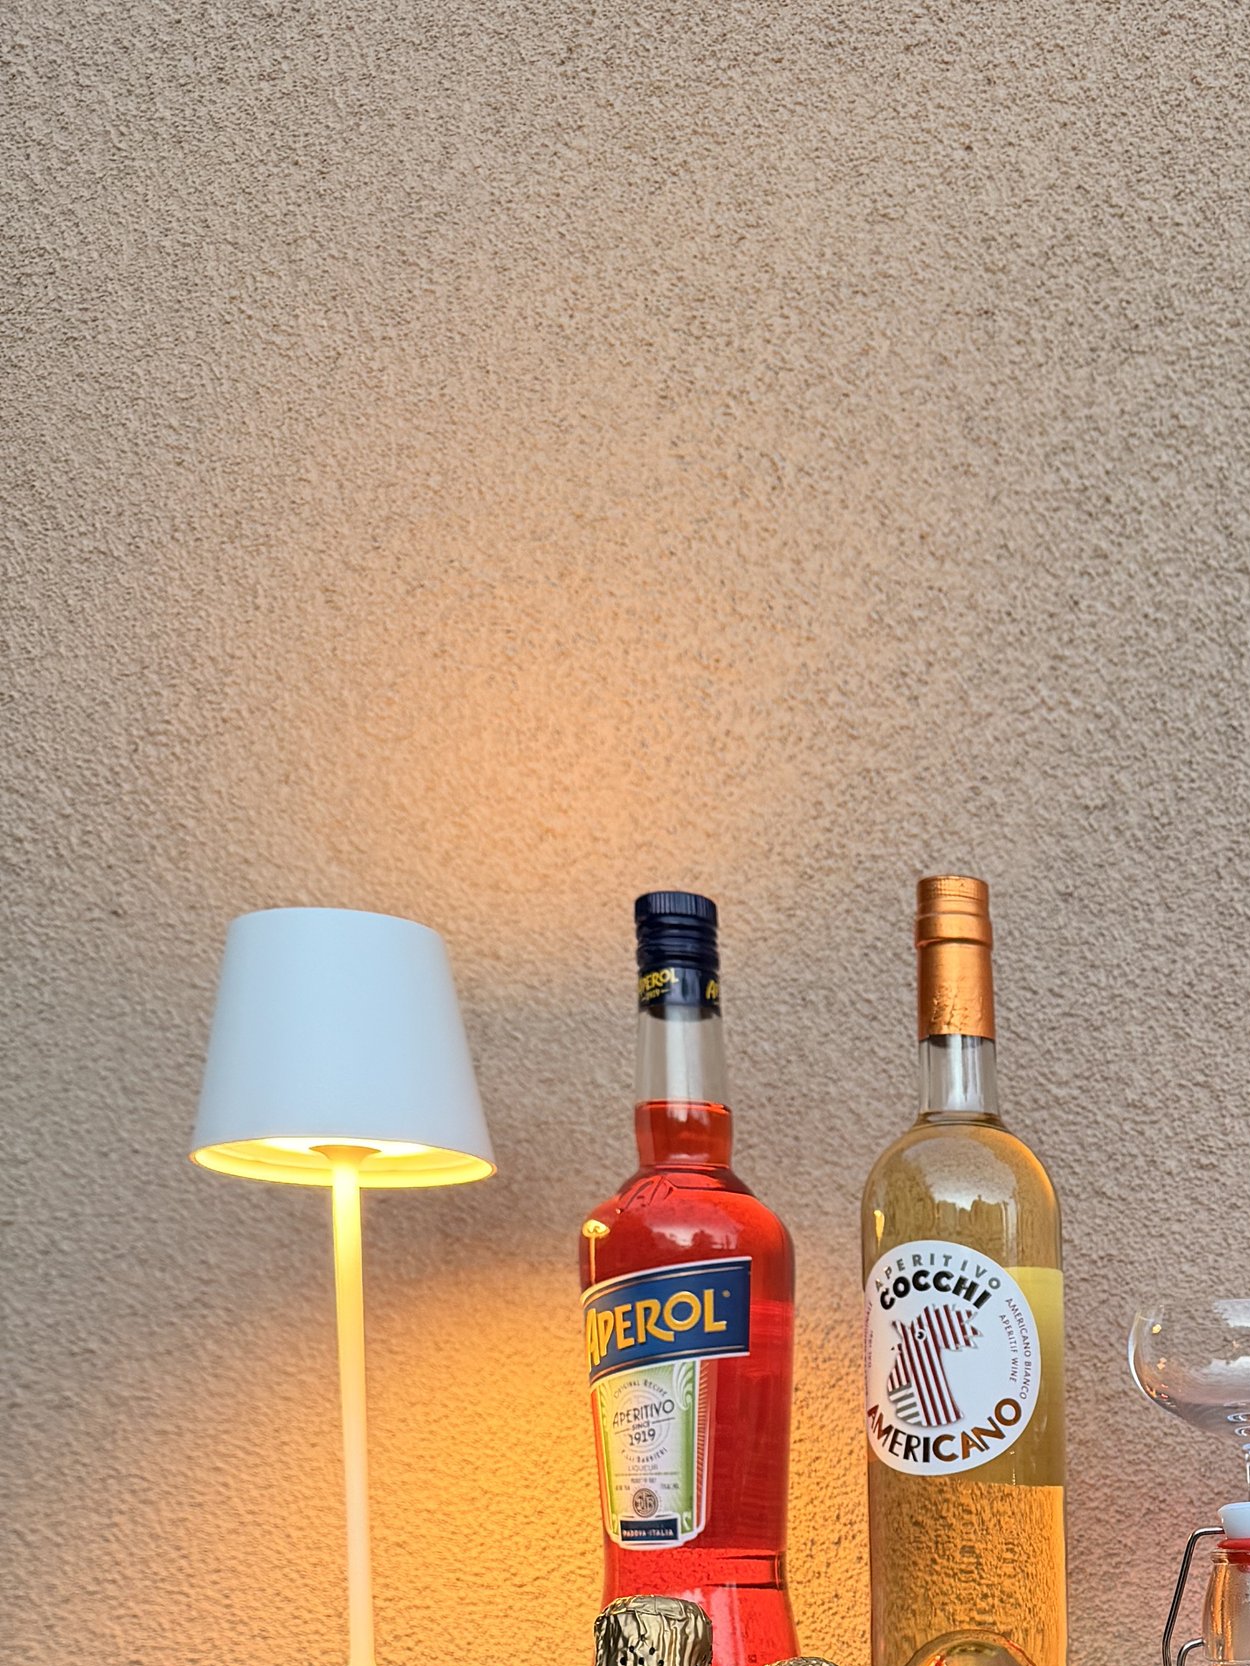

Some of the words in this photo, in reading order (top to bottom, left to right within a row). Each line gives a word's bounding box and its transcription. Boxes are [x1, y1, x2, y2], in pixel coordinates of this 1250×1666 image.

[640, 966, 680, 994] PEROL
[875, 1252, 1002, 1293] APERITIVO
[879, 1269, 993, 1311] COCCHI
[585, 1289, 727, 1370] APEROL
[999, 1314, 1019, 1354] APERITIF
[1009, 1357, 1019, 1383] WINE
[1005, 1298, 1032, 1358] AMERICANO
[1019, 1361, 1032, 1400] BIANCO
[613, 1399, 675, 1429] APERITIVO
[867, 1397, 1022, 1464] AMERICANO
[628, 1428, 656, 1447] 1919
